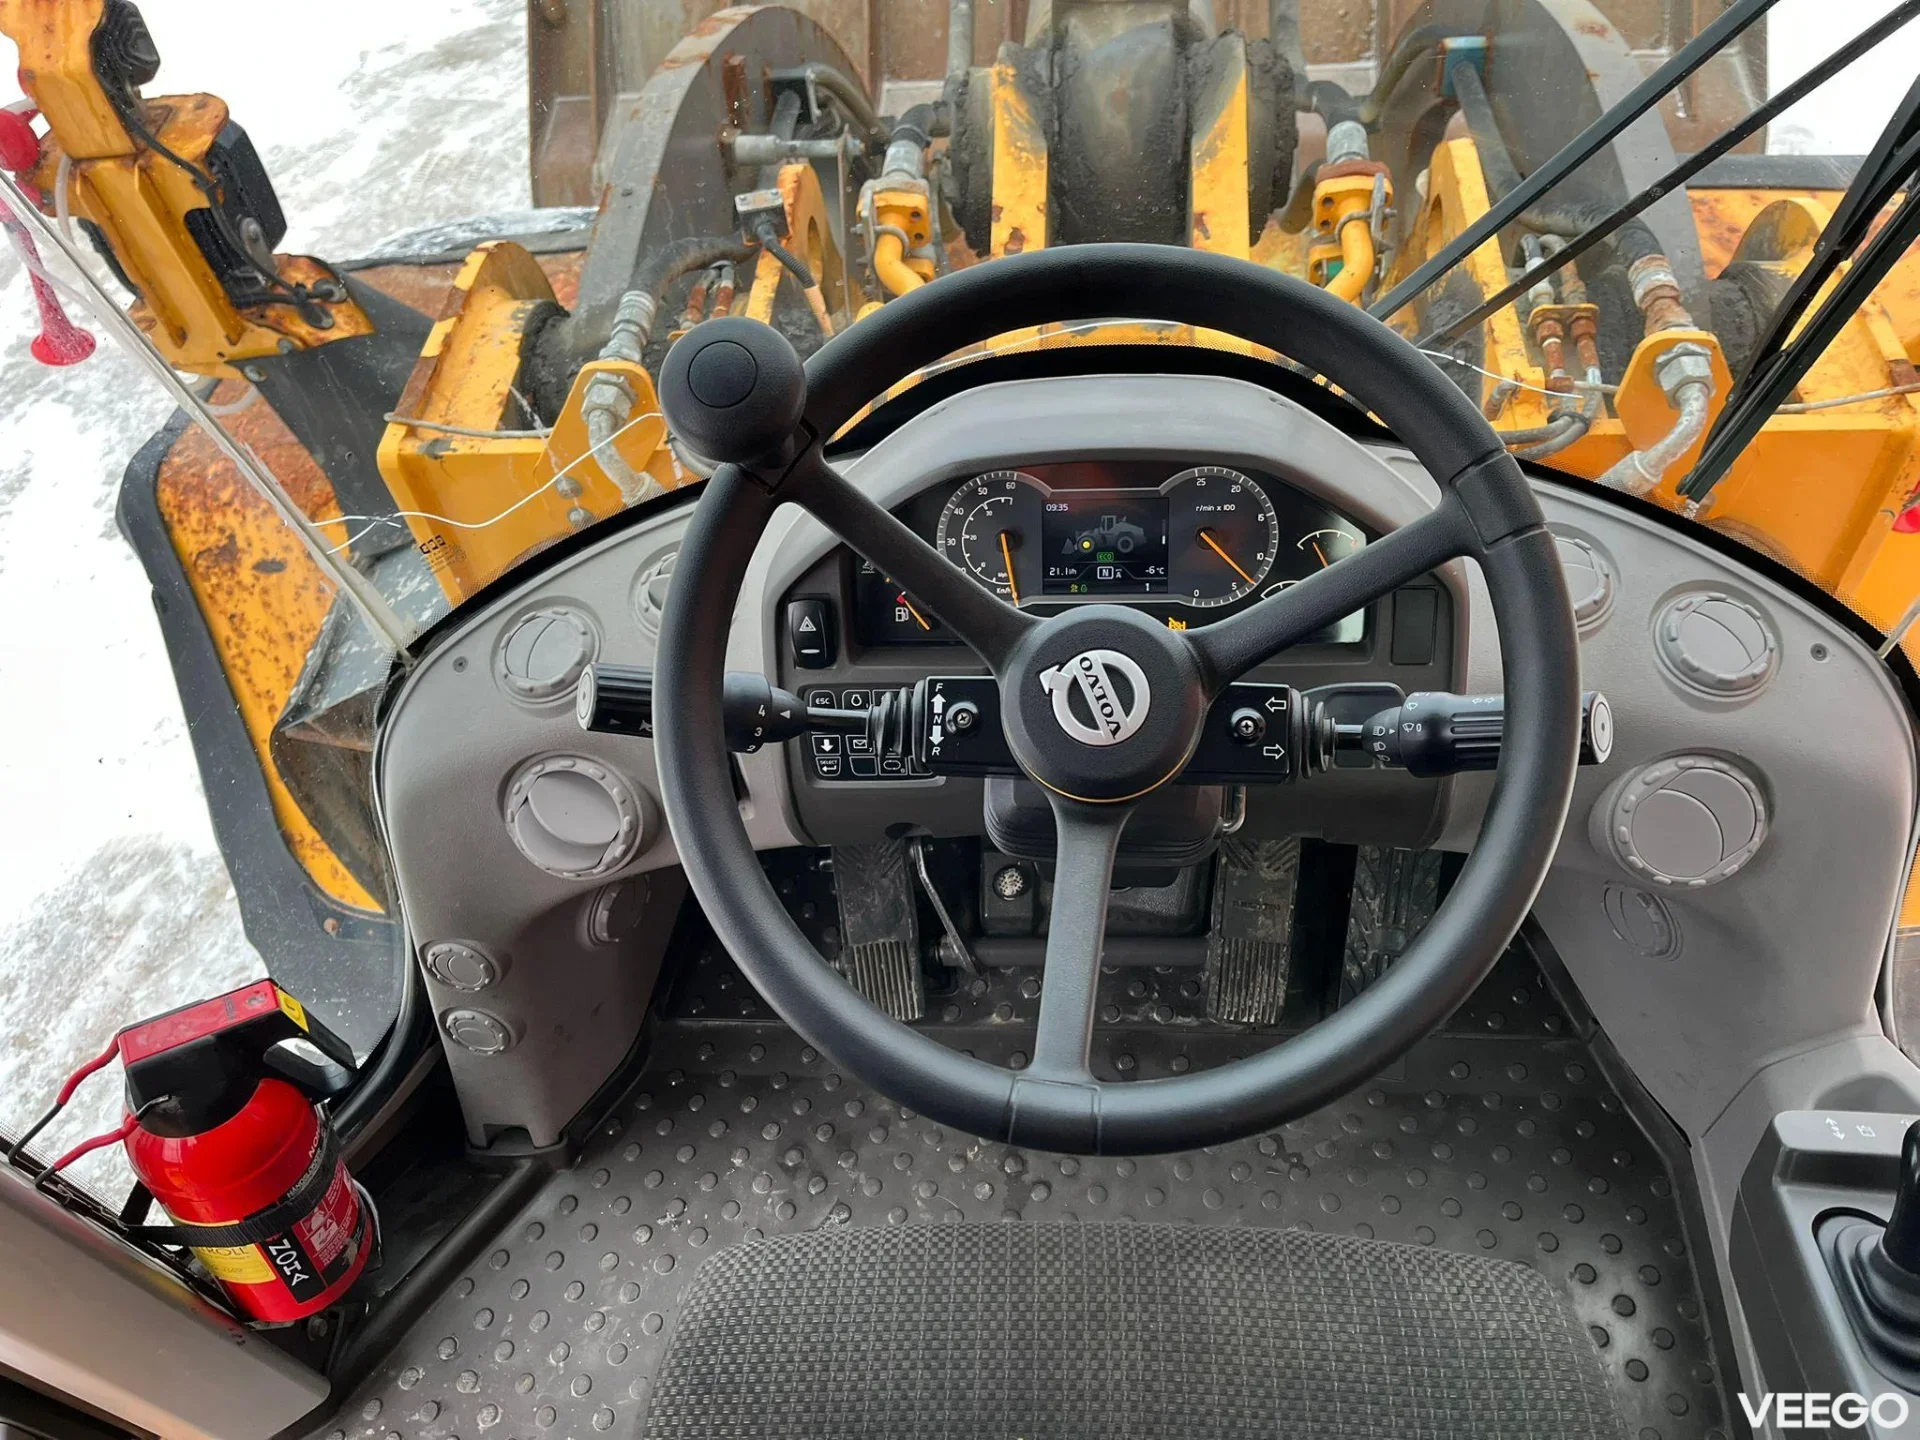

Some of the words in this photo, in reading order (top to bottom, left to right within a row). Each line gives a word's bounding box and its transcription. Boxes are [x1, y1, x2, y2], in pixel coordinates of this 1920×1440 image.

[1196, 478, 1206, 486] 25
[978, 487, 988, 495] 50
[1231, 485, 1241, 493] 20
[936, 683, 944, 692] F
[1080, 656, 1122, 740] VOLVO
[758, 704, 766, 716] 4
[933, 715, 942, 724] N
[754, 727, 762, 736] 3
[932, 747, 941, 756] R
